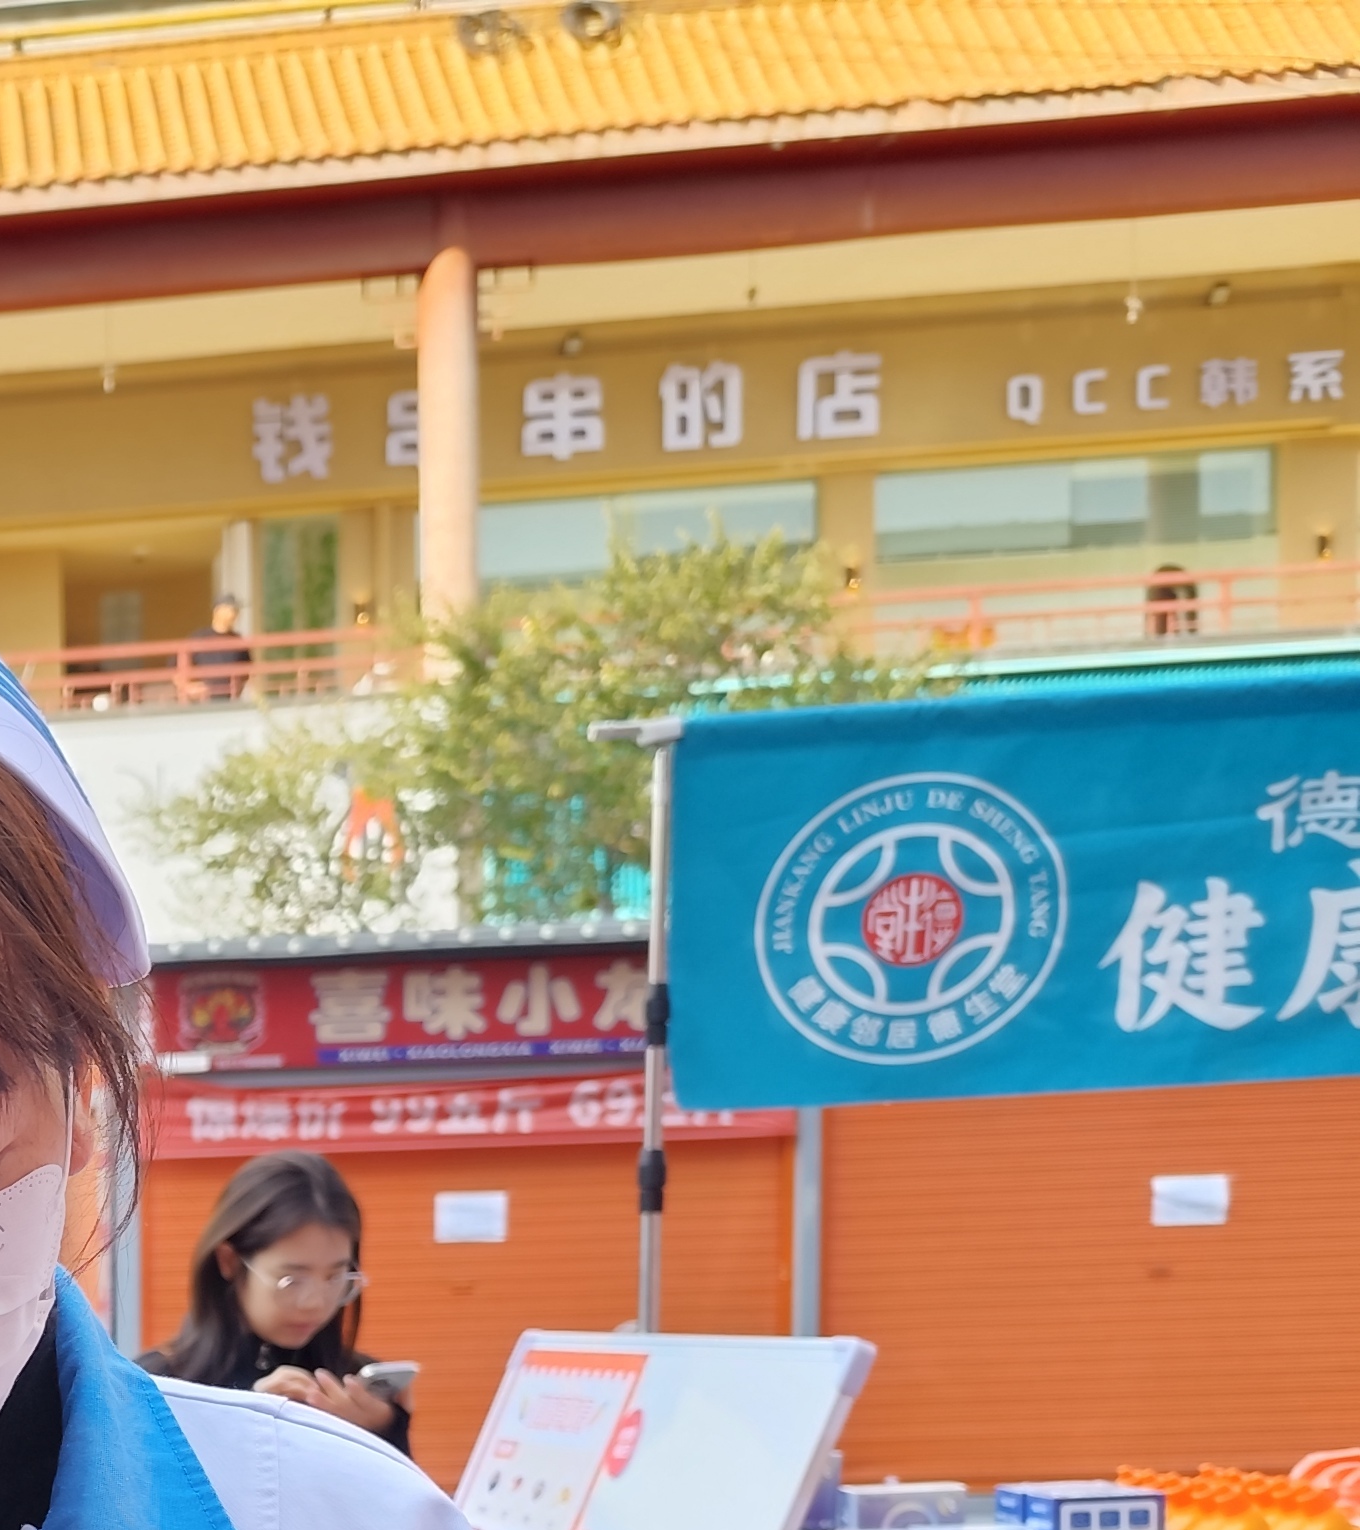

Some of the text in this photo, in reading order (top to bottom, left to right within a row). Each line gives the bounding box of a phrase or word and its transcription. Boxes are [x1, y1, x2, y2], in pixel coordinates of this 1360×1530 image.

[836, 789, 915, 835] LINJU
[925, 788, 966, 812] DE
[968, 798, 1041, 865] SHENG
